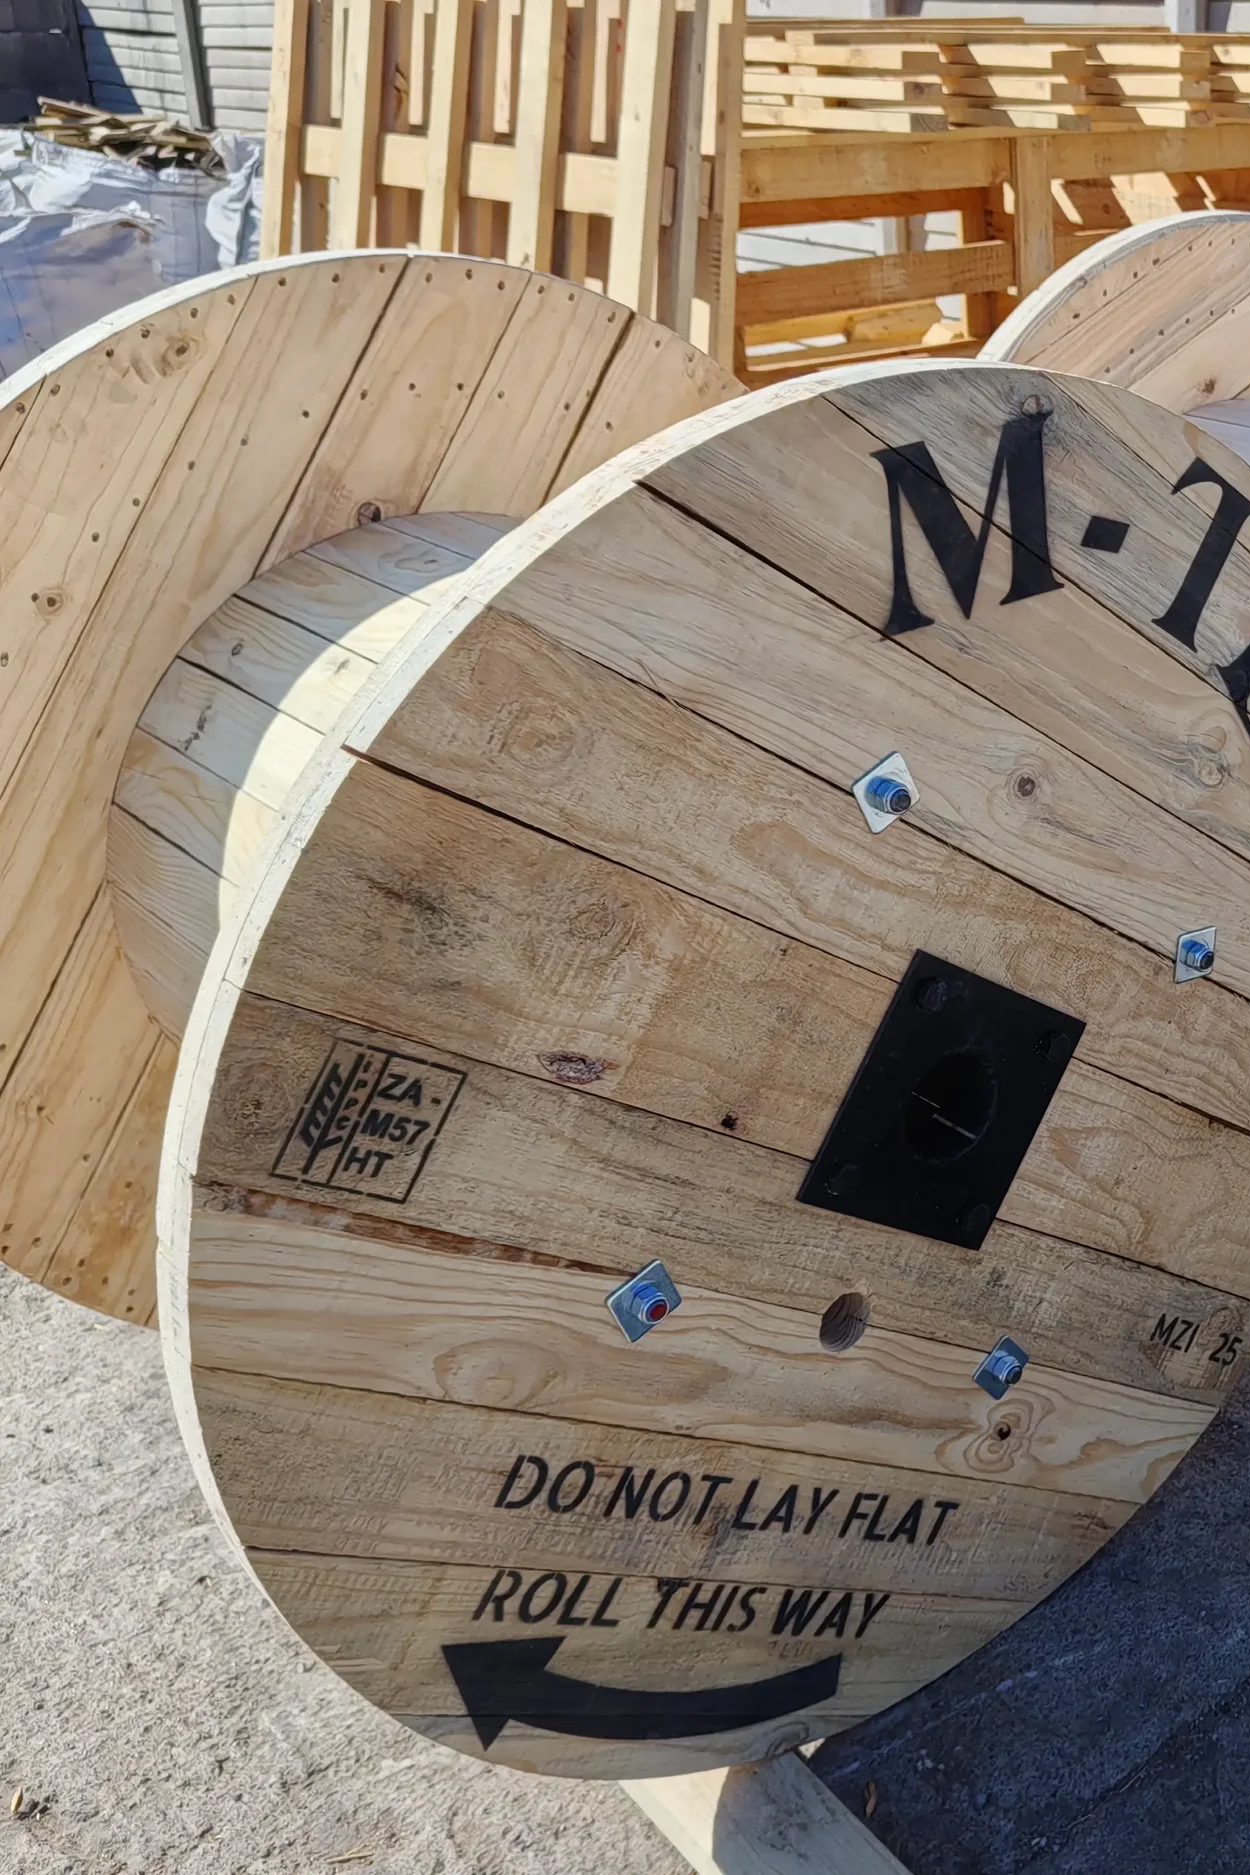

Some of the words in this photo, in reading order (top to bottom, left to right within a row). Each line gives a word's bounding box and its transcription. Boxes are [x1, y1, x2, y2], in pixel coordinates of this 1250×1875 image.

[360, 1108, 431, 1146] M57
[342, 1146, 395, 1179] HT
[1207, 1332, 1244, 1366] 25
[494, 1454, 597, 1514] DO
[602, 1465, 734, 1526] NOT
[731, 1477, 840, 1536] LAY
[838, 1492, 961, 1548] FLAT
[471, 1568, 624, 1628] ROLL
[645, 1577, 767, 1633] THIS
[770, 1587, 891, 1640] WAY
